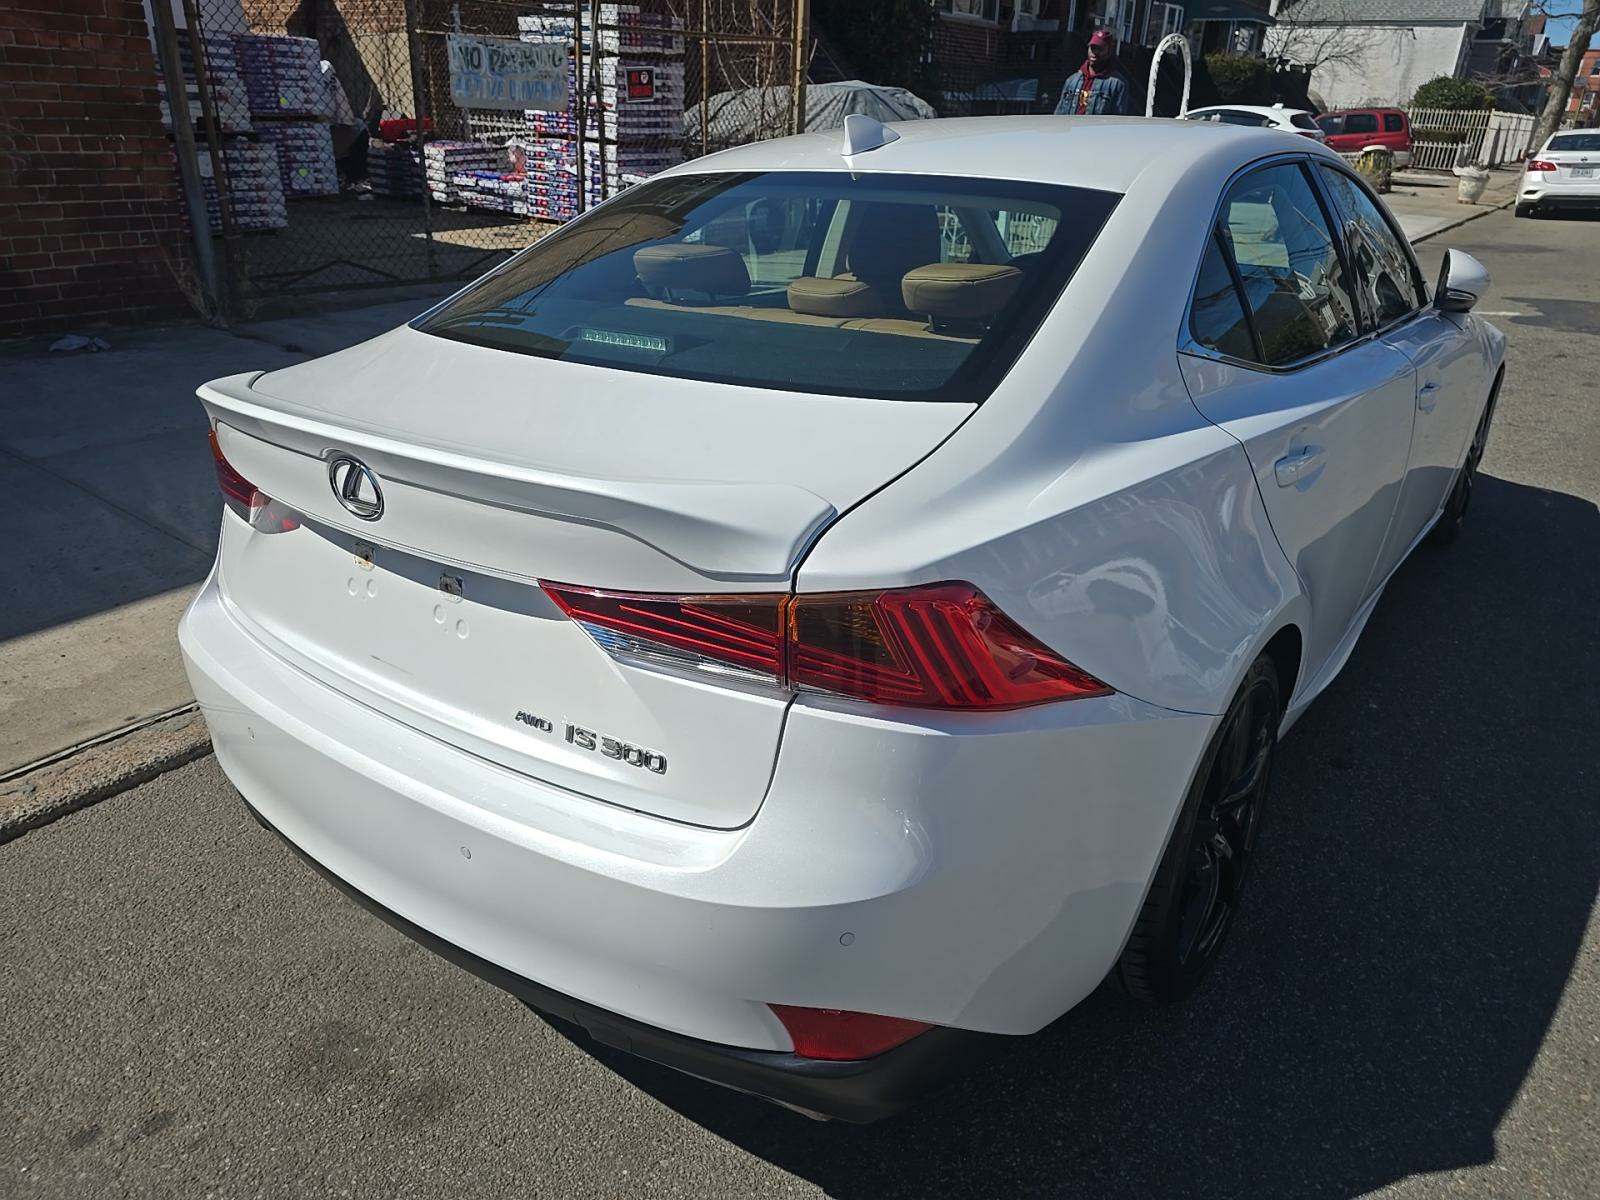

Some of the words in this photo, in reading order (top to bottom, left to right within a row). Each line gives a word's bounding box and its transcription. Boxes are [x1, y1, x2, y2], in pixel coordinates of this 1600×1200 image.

[457, 43, 482, 72] NO
[515, 710, 553, 733] AWD
[565, 722, 597, 751] IS
[600, 733, 668, 775] 300
